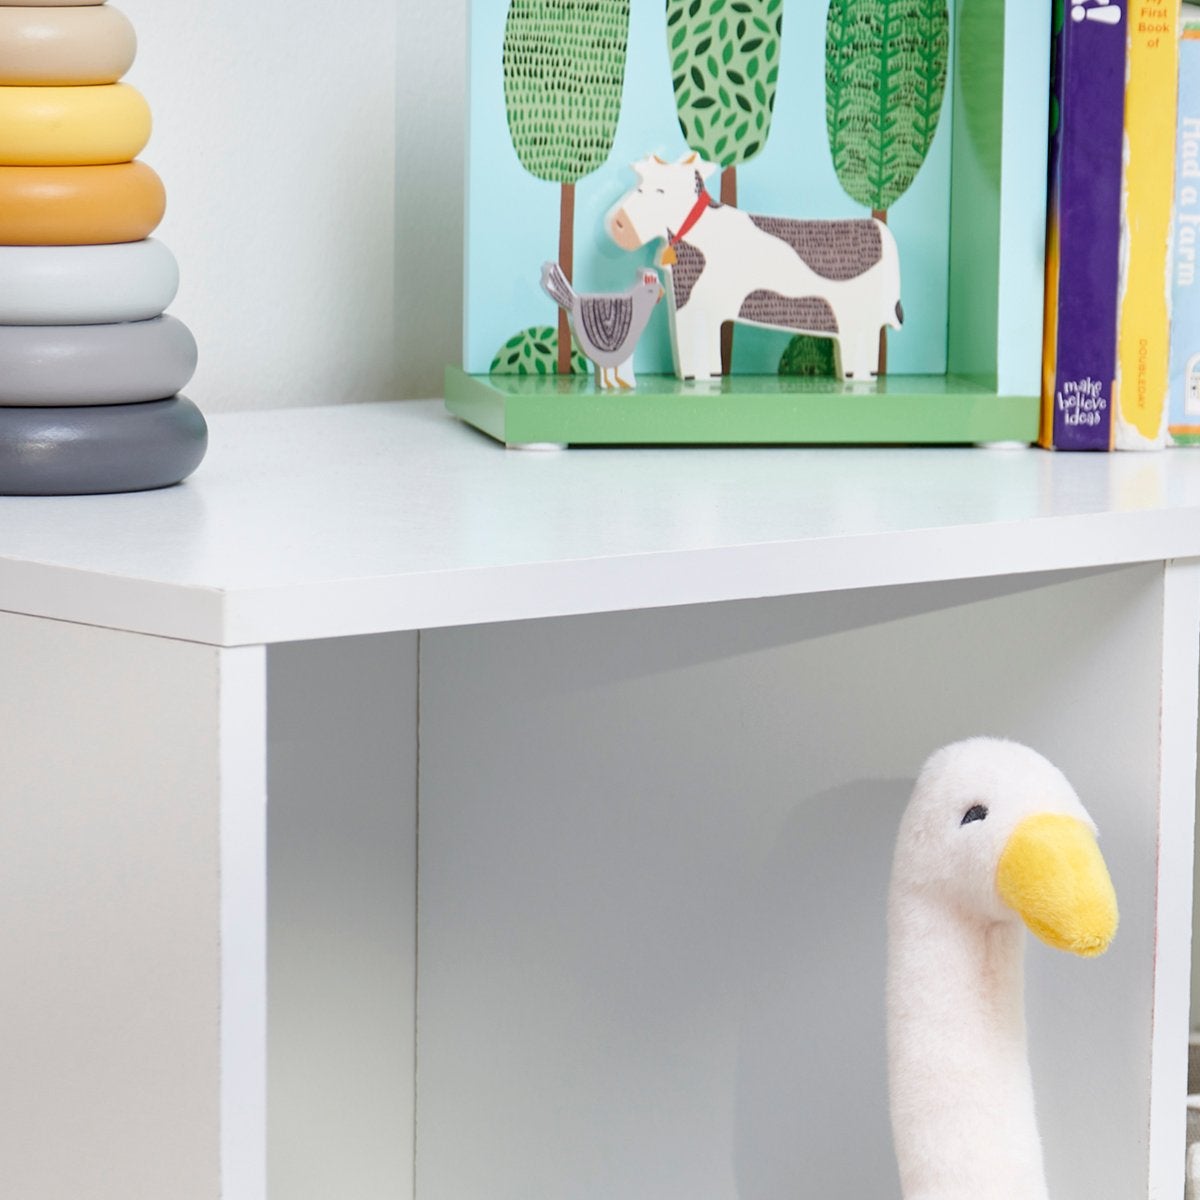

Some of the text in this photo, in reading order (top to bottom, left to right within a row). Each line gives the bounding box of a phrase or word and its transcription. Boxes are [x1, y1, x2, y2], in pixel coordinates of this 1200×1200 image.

[1141, 8, 1167, 18] First
[1138, 23, 1170, 32] Book
[1147, 38, 1160, 48] of
[1181, 186, 1198, 205] a
[1064, 377, 1102, 398] make
[1057, 391, 1107, 410] believe
[1064, 408, 1101, 426] ideas
